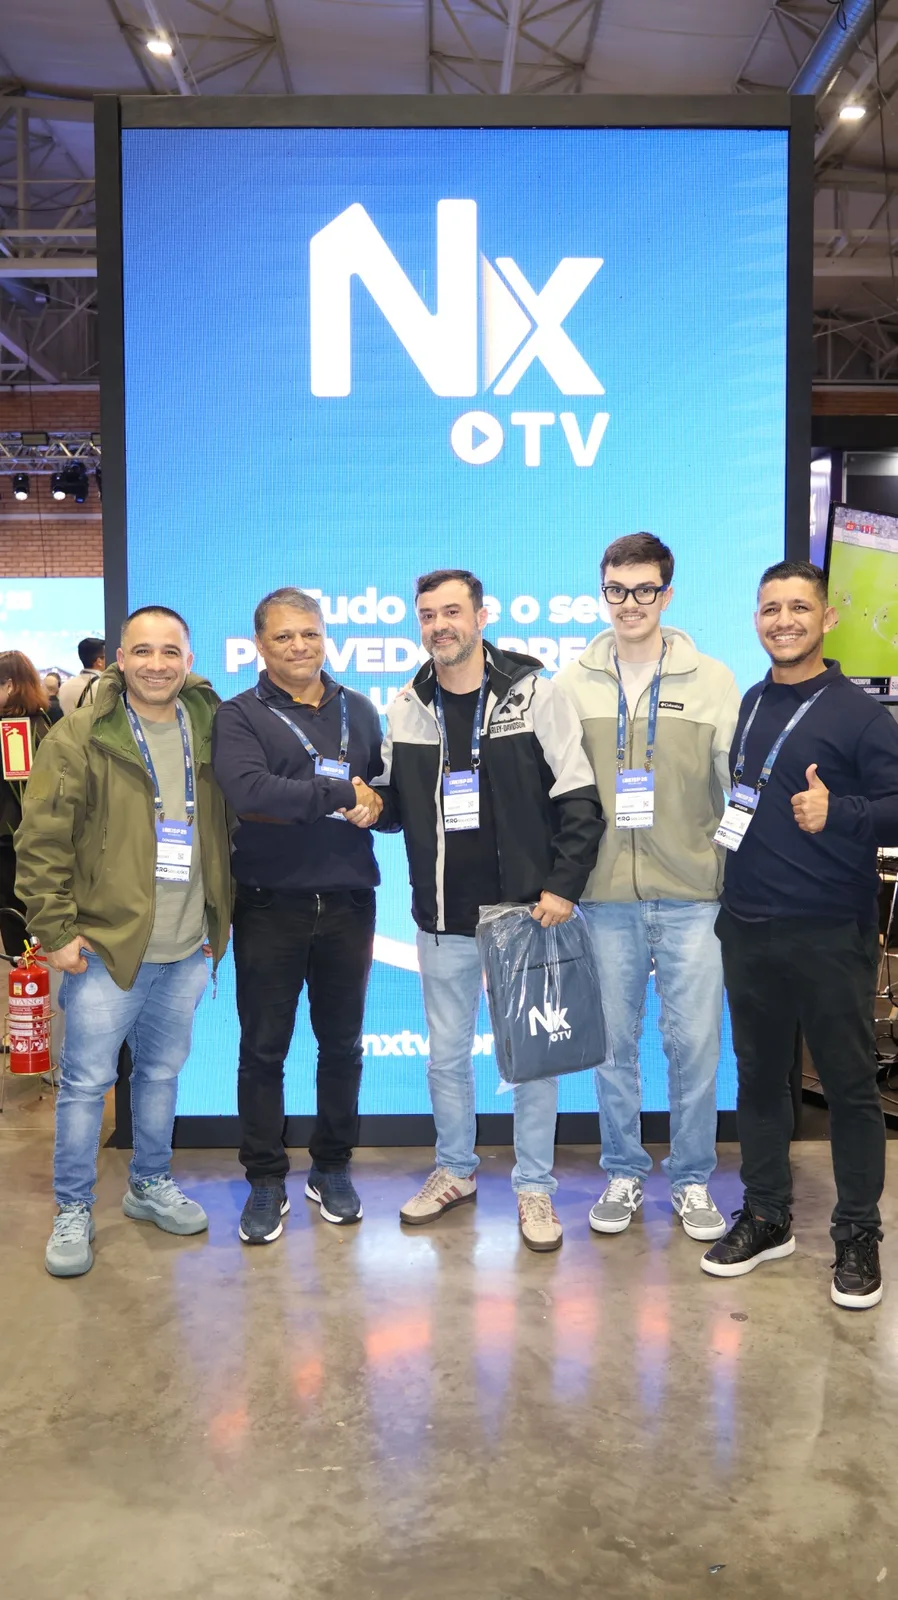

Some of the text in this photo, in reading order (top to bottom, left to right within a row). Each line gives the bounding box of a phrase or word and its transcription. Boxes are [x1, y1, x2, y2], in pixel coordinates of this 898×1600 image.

[510, 595, 540, 624] o
[226, 638, 432, 672] PVED
[490, 721, 526, 734] RLEY-DAVIDSON
